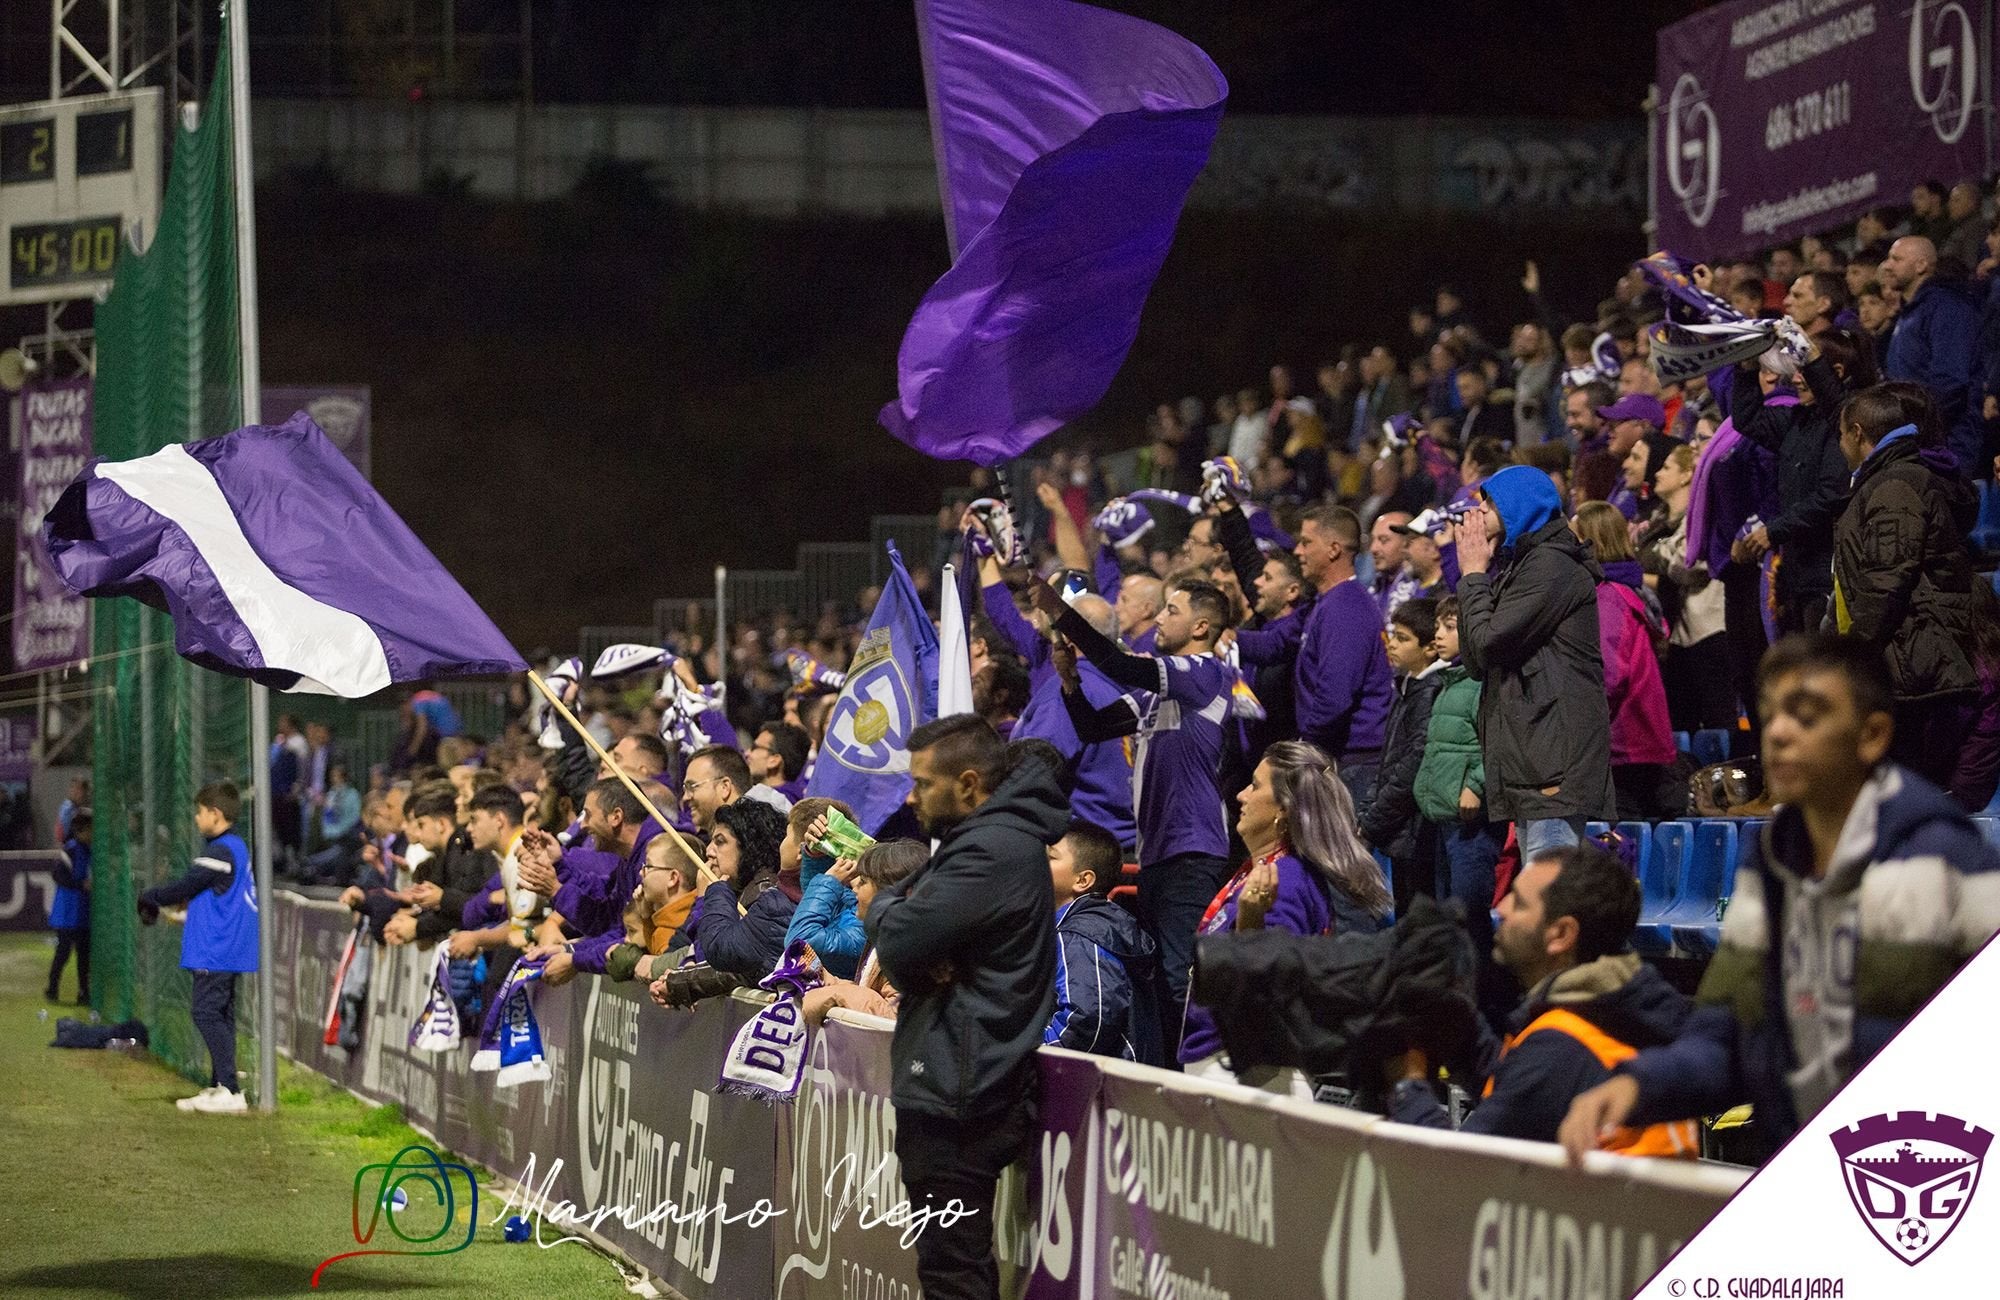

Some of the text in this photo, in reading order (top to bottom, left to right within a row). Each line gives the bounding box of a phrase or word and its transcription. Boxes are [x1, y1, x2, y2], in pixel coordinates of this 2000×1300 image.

[28, 122, 127, 173] 2 1
[606, 1060, 681, 1250] Ramos
[673, 1089, 734, 1285] Bus
[1104, 1108, 1275, 1248] GUADALAJARA
[1110, 1235, 1146, 1296] Calle
[1468, 1198, 1682, 1300] GUADALA
